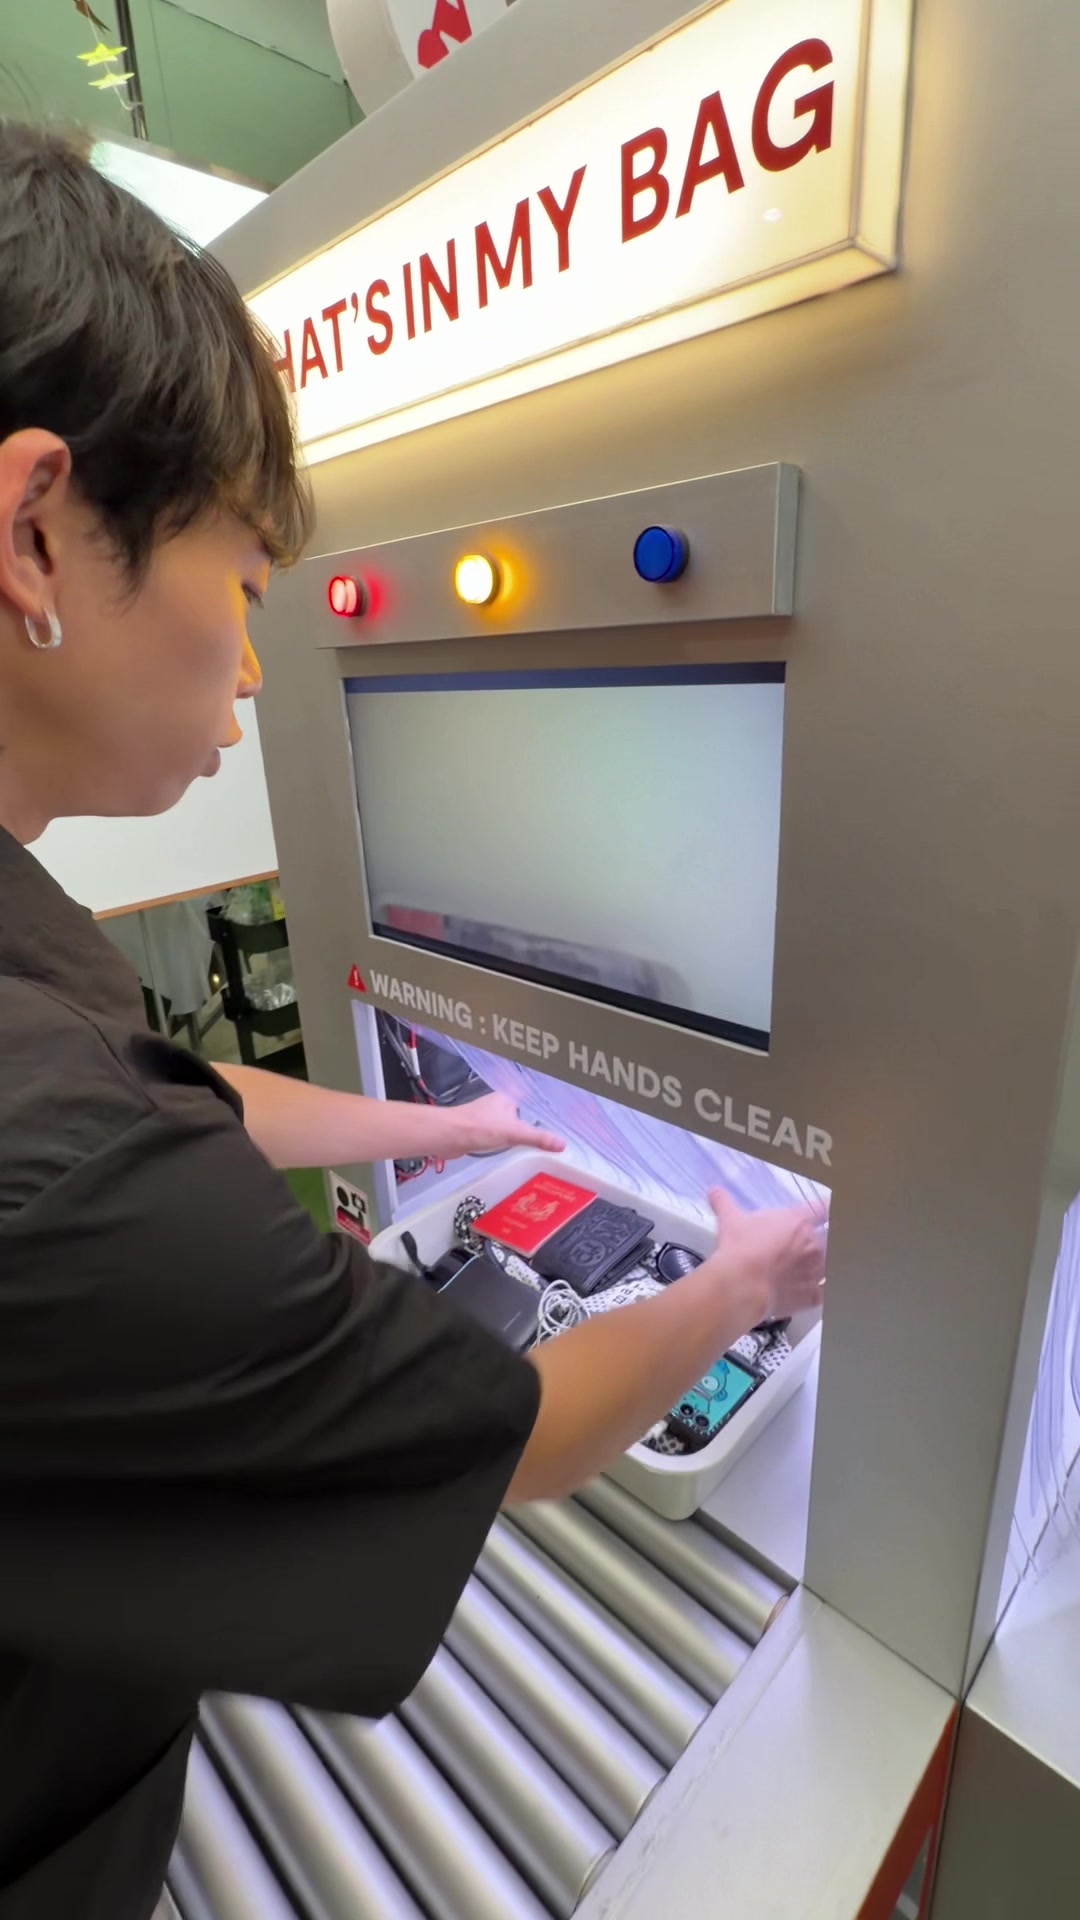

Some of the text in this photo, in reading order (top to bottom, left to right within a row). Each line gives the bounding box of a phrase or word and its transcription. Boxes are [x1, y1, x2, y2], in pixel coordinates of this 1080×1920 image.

[272, 37, 835, 393] HAT'S IN MY BAG
[368, 968, 473, 1030] WARNING
[492, 1013, 560, 1060] KEEP
[568, 1040, 683, 1108] HANDS
[694, 1088, 833, 1168] CLEAR
